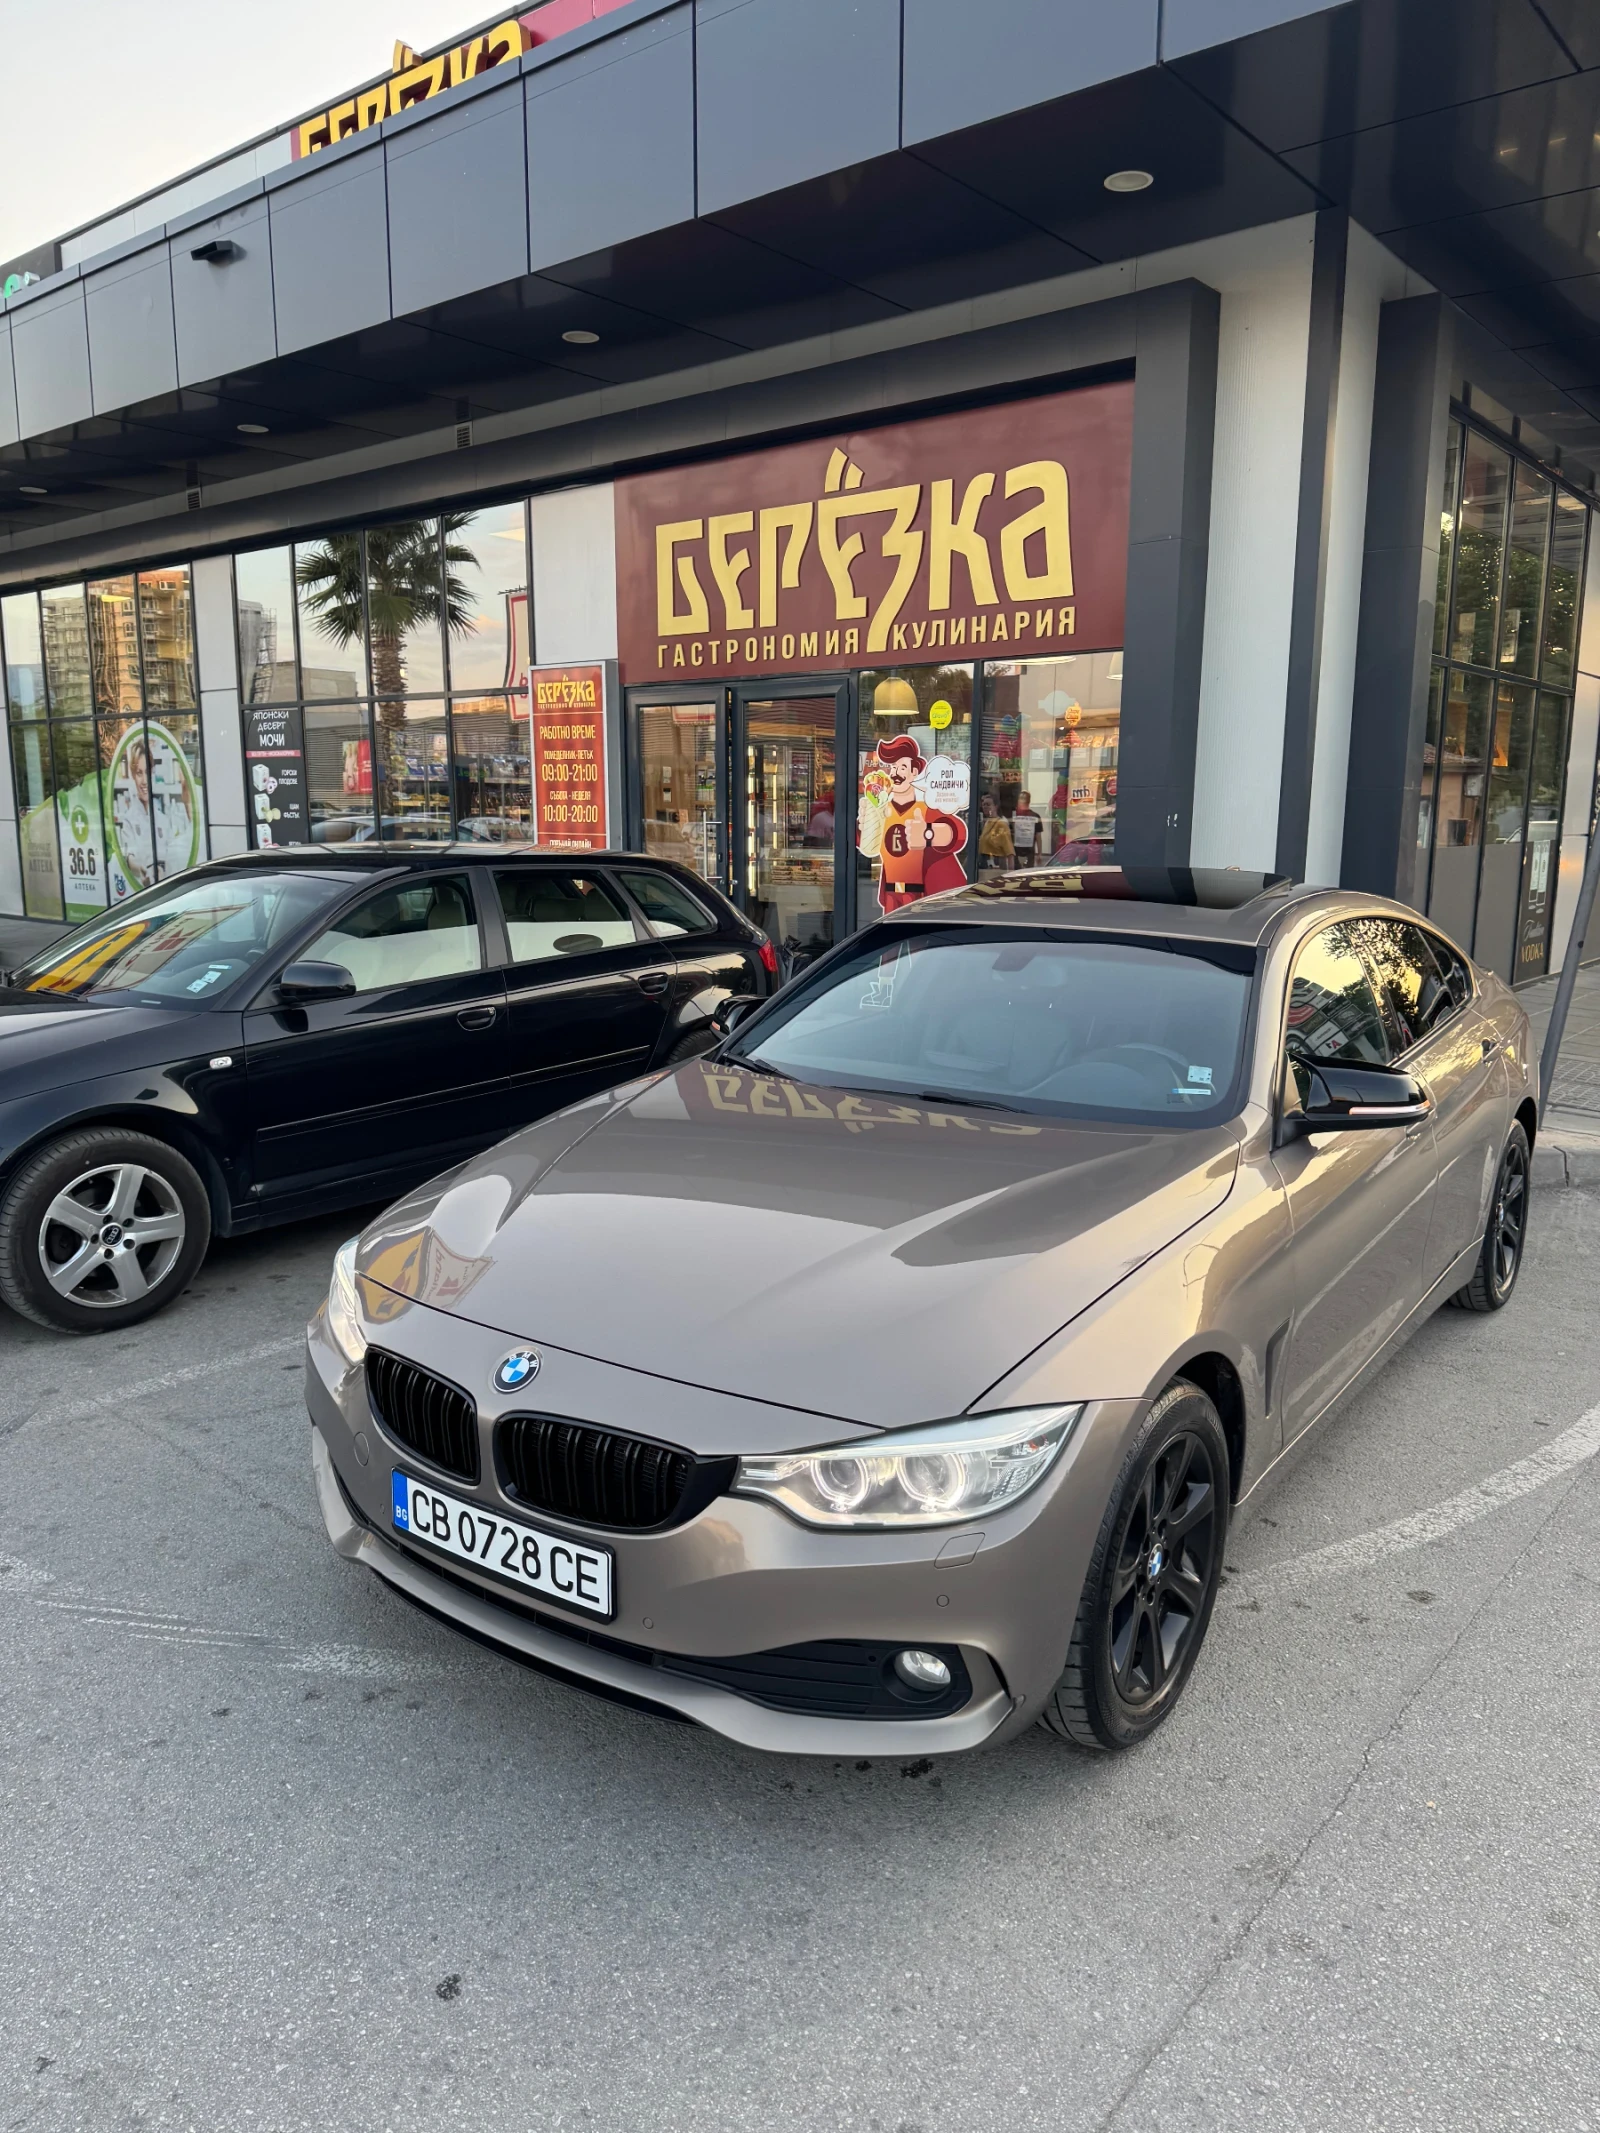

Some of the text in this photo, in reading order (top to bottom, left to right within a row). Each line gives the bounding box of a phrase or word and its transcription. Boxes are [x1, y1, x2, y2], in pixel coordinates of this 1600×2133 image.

[658, 606, 1076, 668] ГАСТРОНОМИЯ КУЛИНАРИЯ
[252, 711, 290, 720] ЯПОНСКИ
[257, 721, 286, 731] ДЕСЕРТ
[540, 724, 596, 740] РАБОТНО ВРЕМЕ
[259, 734, 285, 747] МОЧИ
[541, 763, 598, 782] 09:00-21:00
[941, 769, 954, 779] РОЛ
[930, 780, 964, 790] САНДВИЧИ
[543, 804, 598, 823] 10:00-20:00
[74, 882, 96, 891] АПТЕКА
[395, 1489, 600, 1604] BG CB 0728 CE
